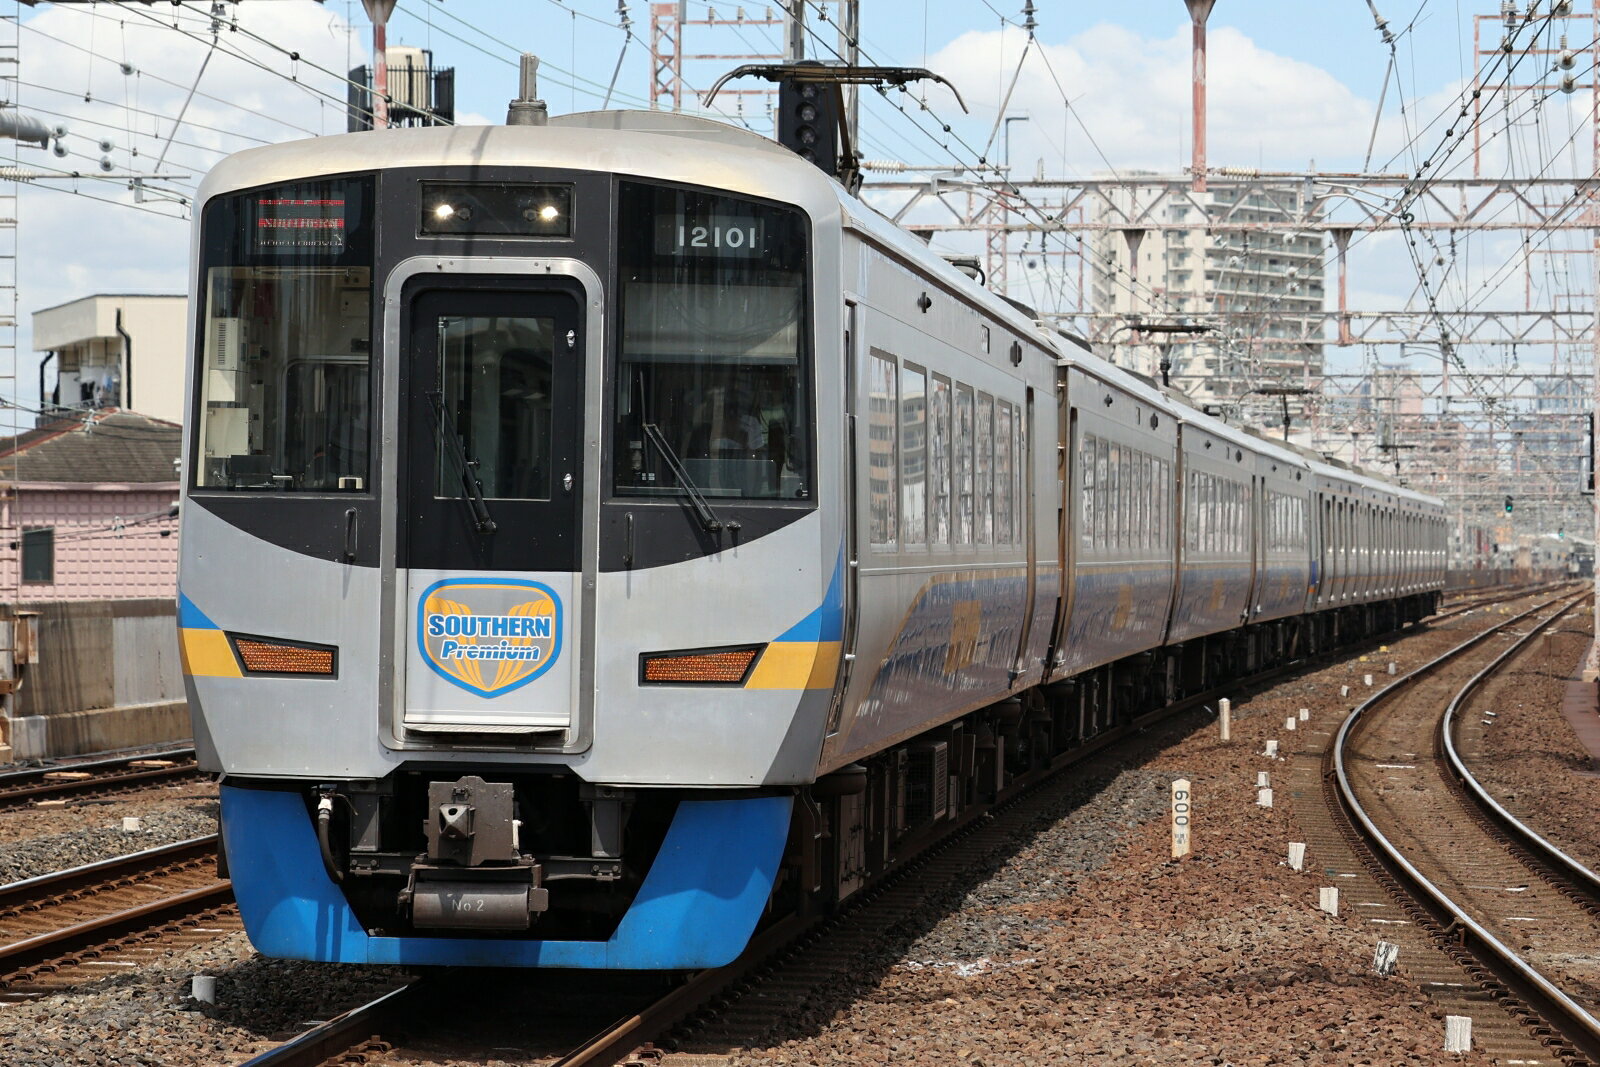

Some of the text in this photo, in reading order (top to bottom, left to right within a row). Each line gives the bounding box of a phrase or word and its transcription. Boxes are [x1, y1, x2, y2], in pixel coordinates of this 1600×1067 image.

[679, 225, 756, 249] 12101
[428, 614, 552, 638] SOUTHERN
[441, 639, 540, 661] Premium
